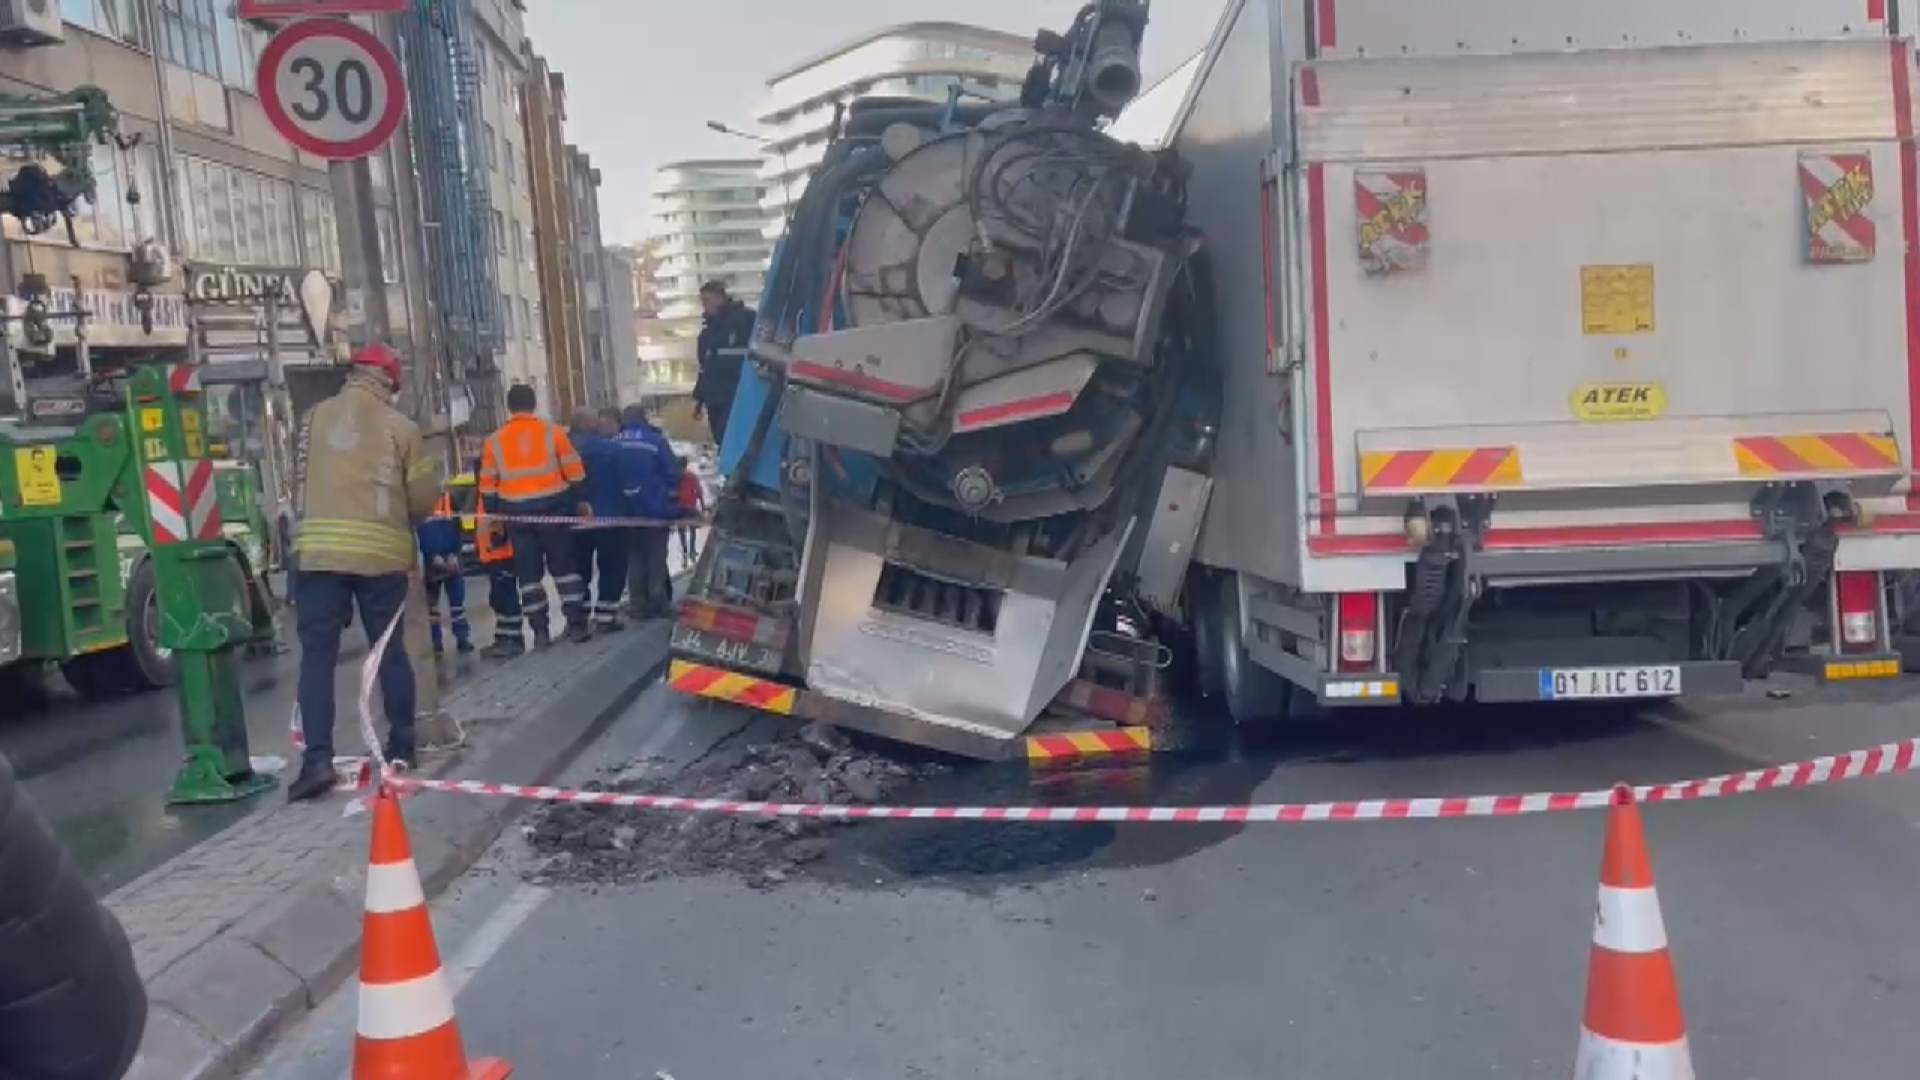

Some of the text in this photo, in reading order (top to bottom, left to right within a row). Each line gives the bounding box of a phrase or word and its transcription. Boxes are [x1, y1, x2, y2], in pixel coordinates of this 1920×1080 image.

[290, 57, 372, 124] 30
[1583, 386, 1650, 404] ATEK
[1555, 672, 1578, 695] 01
[1635, 668, 1676, 692] 612
